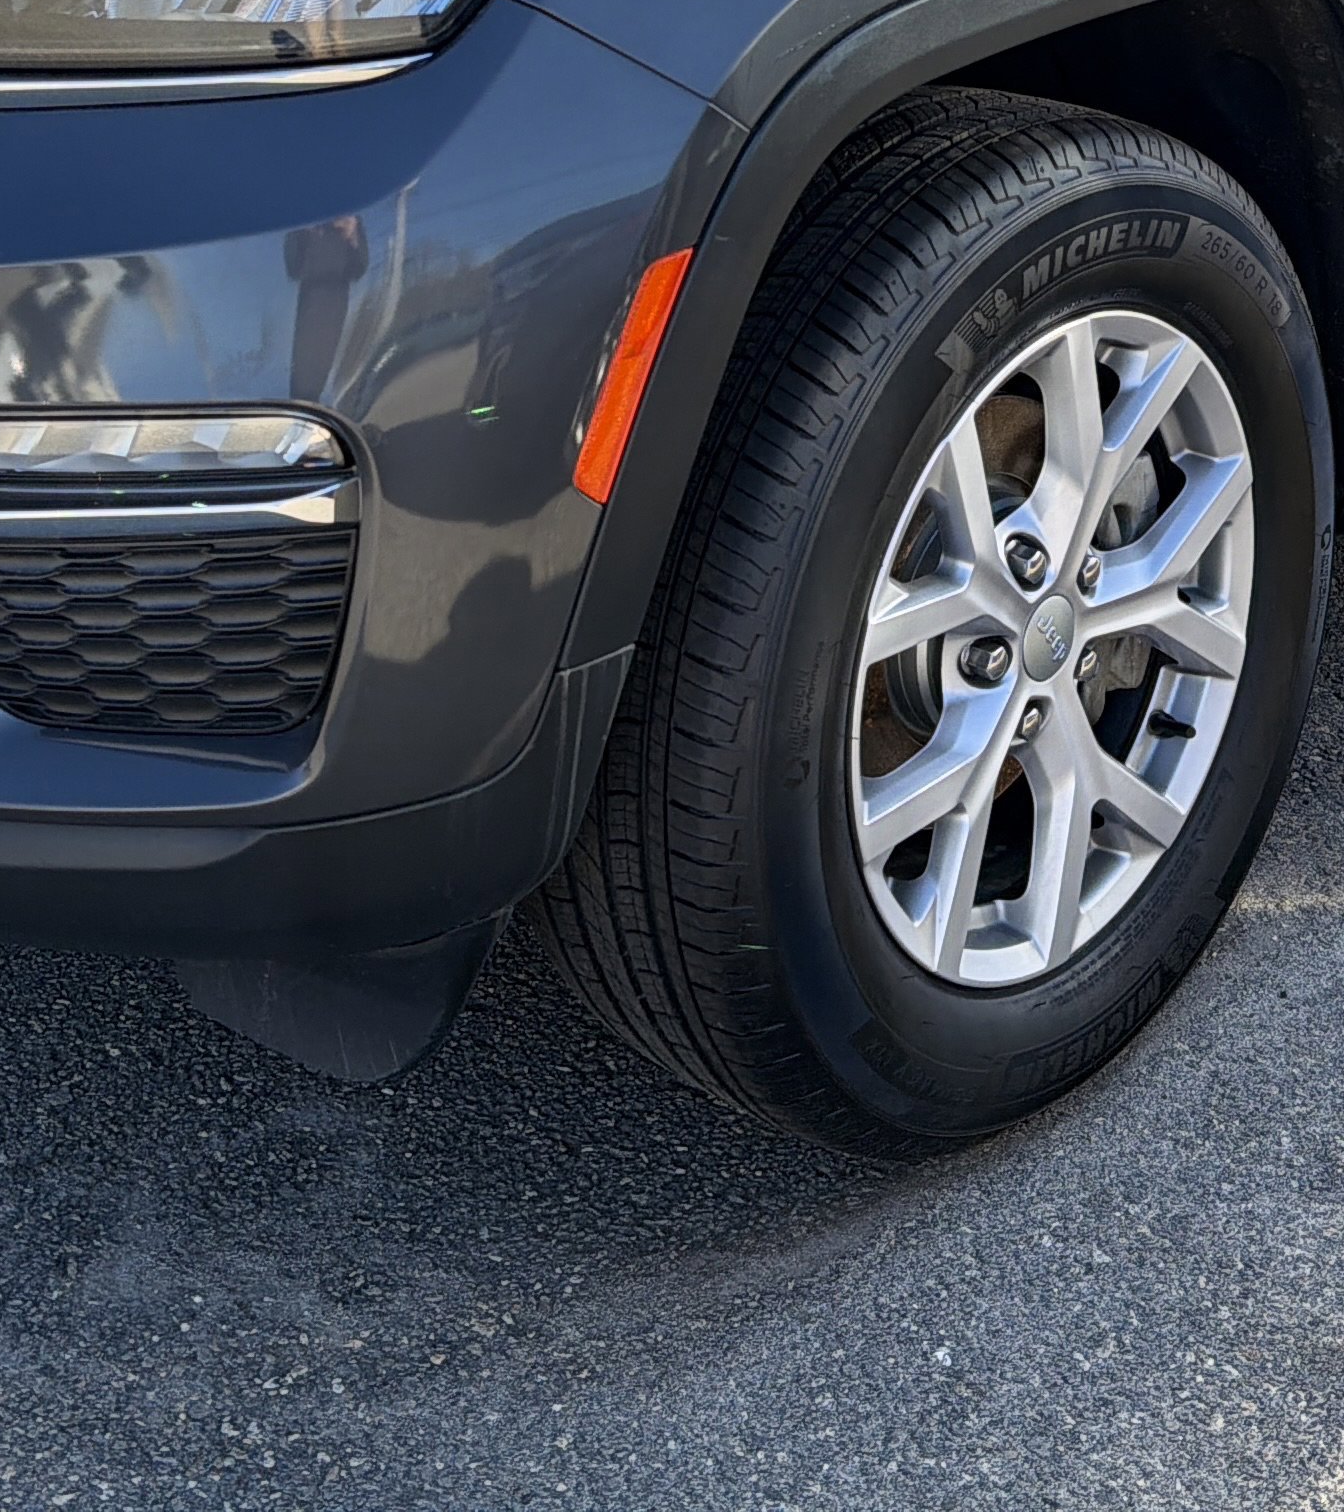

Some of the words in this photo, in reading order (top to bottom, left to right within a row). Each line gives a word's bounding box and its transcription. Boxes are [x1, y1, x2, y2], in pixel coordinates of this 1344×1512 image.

[1020, 218, 1182, 300] MICHELIN
[1201, 231, 1256, 280] 265/60
[1256, 276, 1268, 296] R
[1267, 293, 1282, 316] 18
[1037, 615, 1067, 661] Jeep
